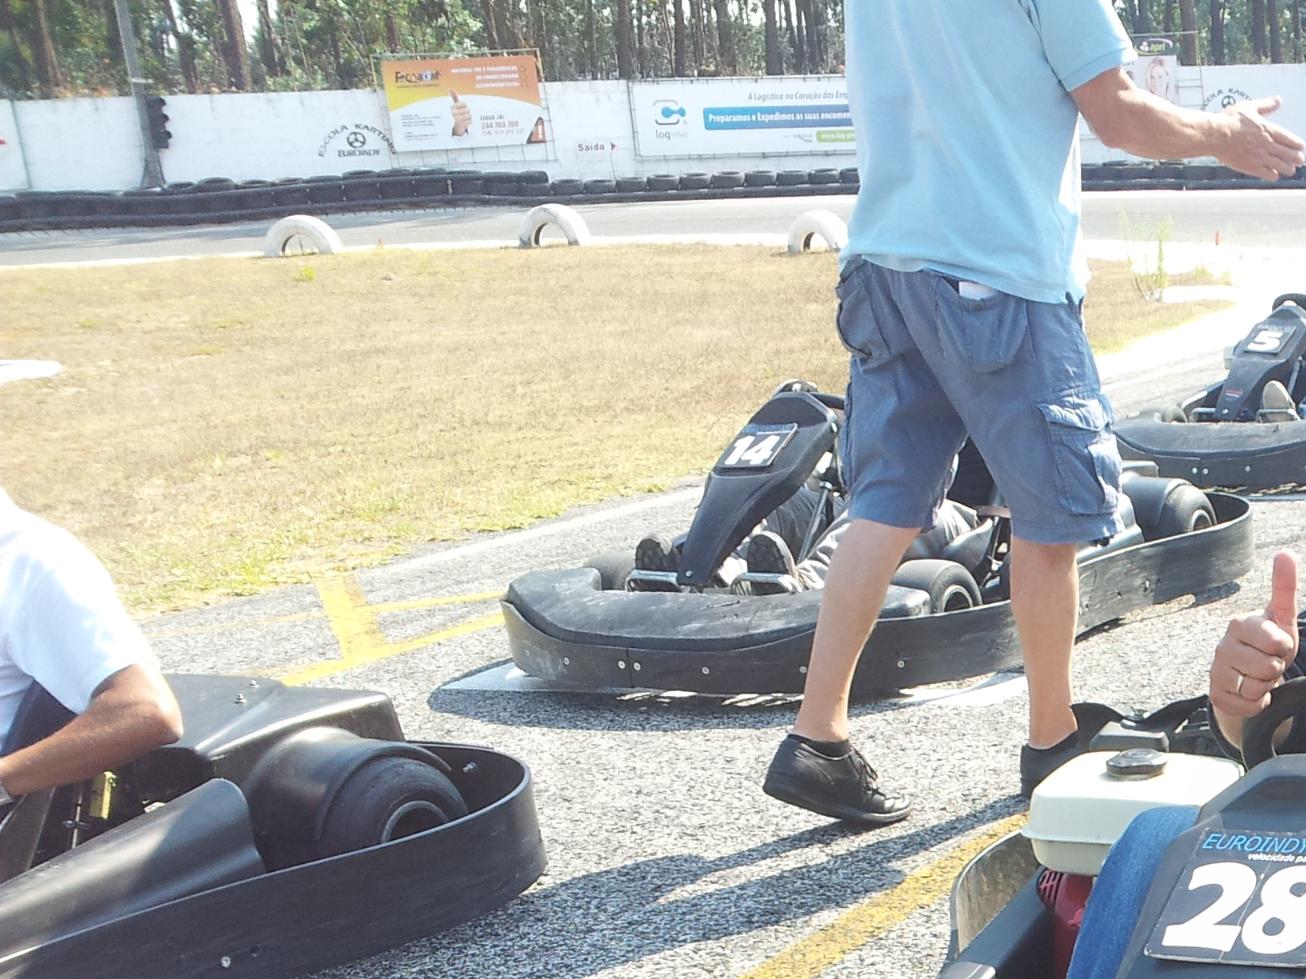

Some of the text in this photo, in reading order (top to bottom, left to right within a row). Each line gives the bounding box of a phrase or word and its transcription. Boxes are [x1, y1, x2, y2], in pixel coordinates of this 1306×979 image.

[709, 113, 751, 124] Preparamos
[757, 112, 794, 123] Expedimos
[804, 112, 820, 120] suas
[318, 125, 347, 157] ESCOLA
[337, 149, 380, 157] EUROINDY
[1247, 330, 1283, 351] 5
[724, 435, 780, 465] 14
[1248, 853, 1295, 863] velocidade
